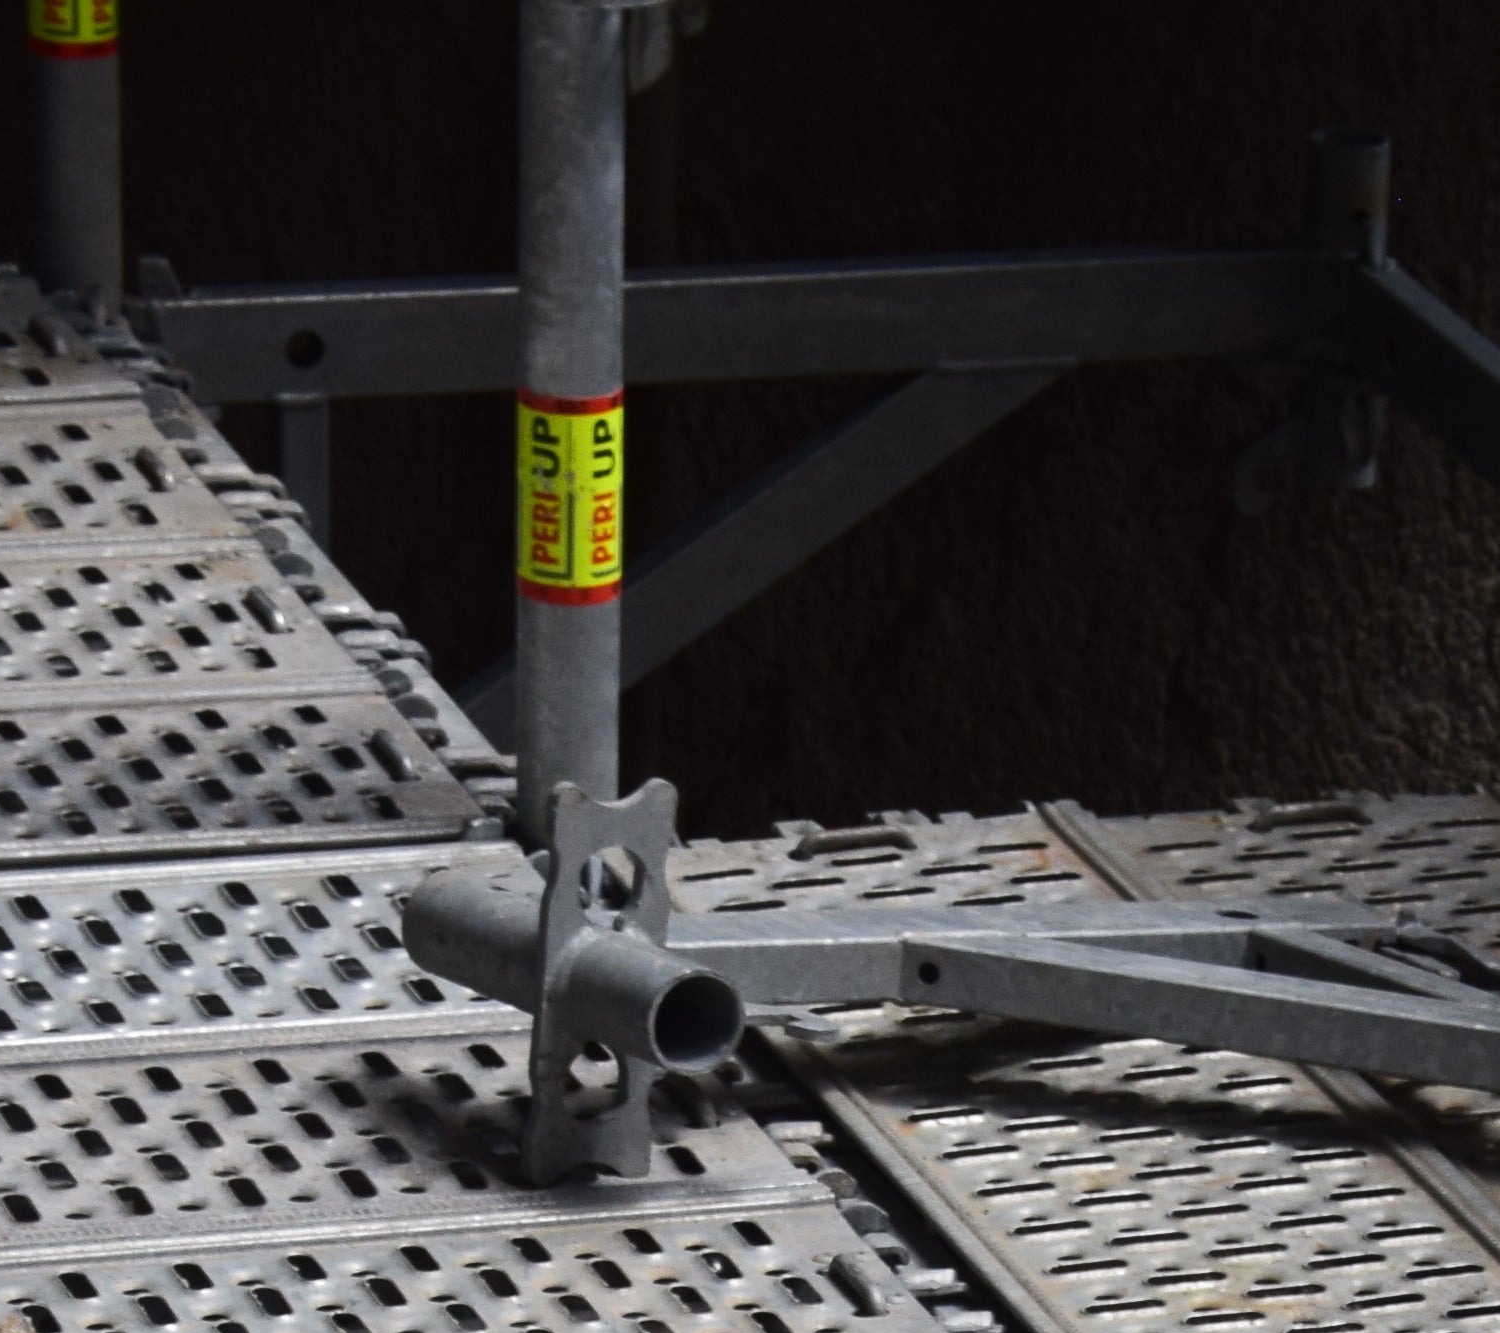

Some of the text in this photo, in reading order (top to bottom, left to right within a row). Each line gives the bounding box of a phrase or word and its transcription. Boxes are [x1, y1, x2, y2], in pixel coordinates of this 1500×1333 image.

[531, 416, 560, 565] PERI UP
[592, 418, 616, 565] PERI UP
